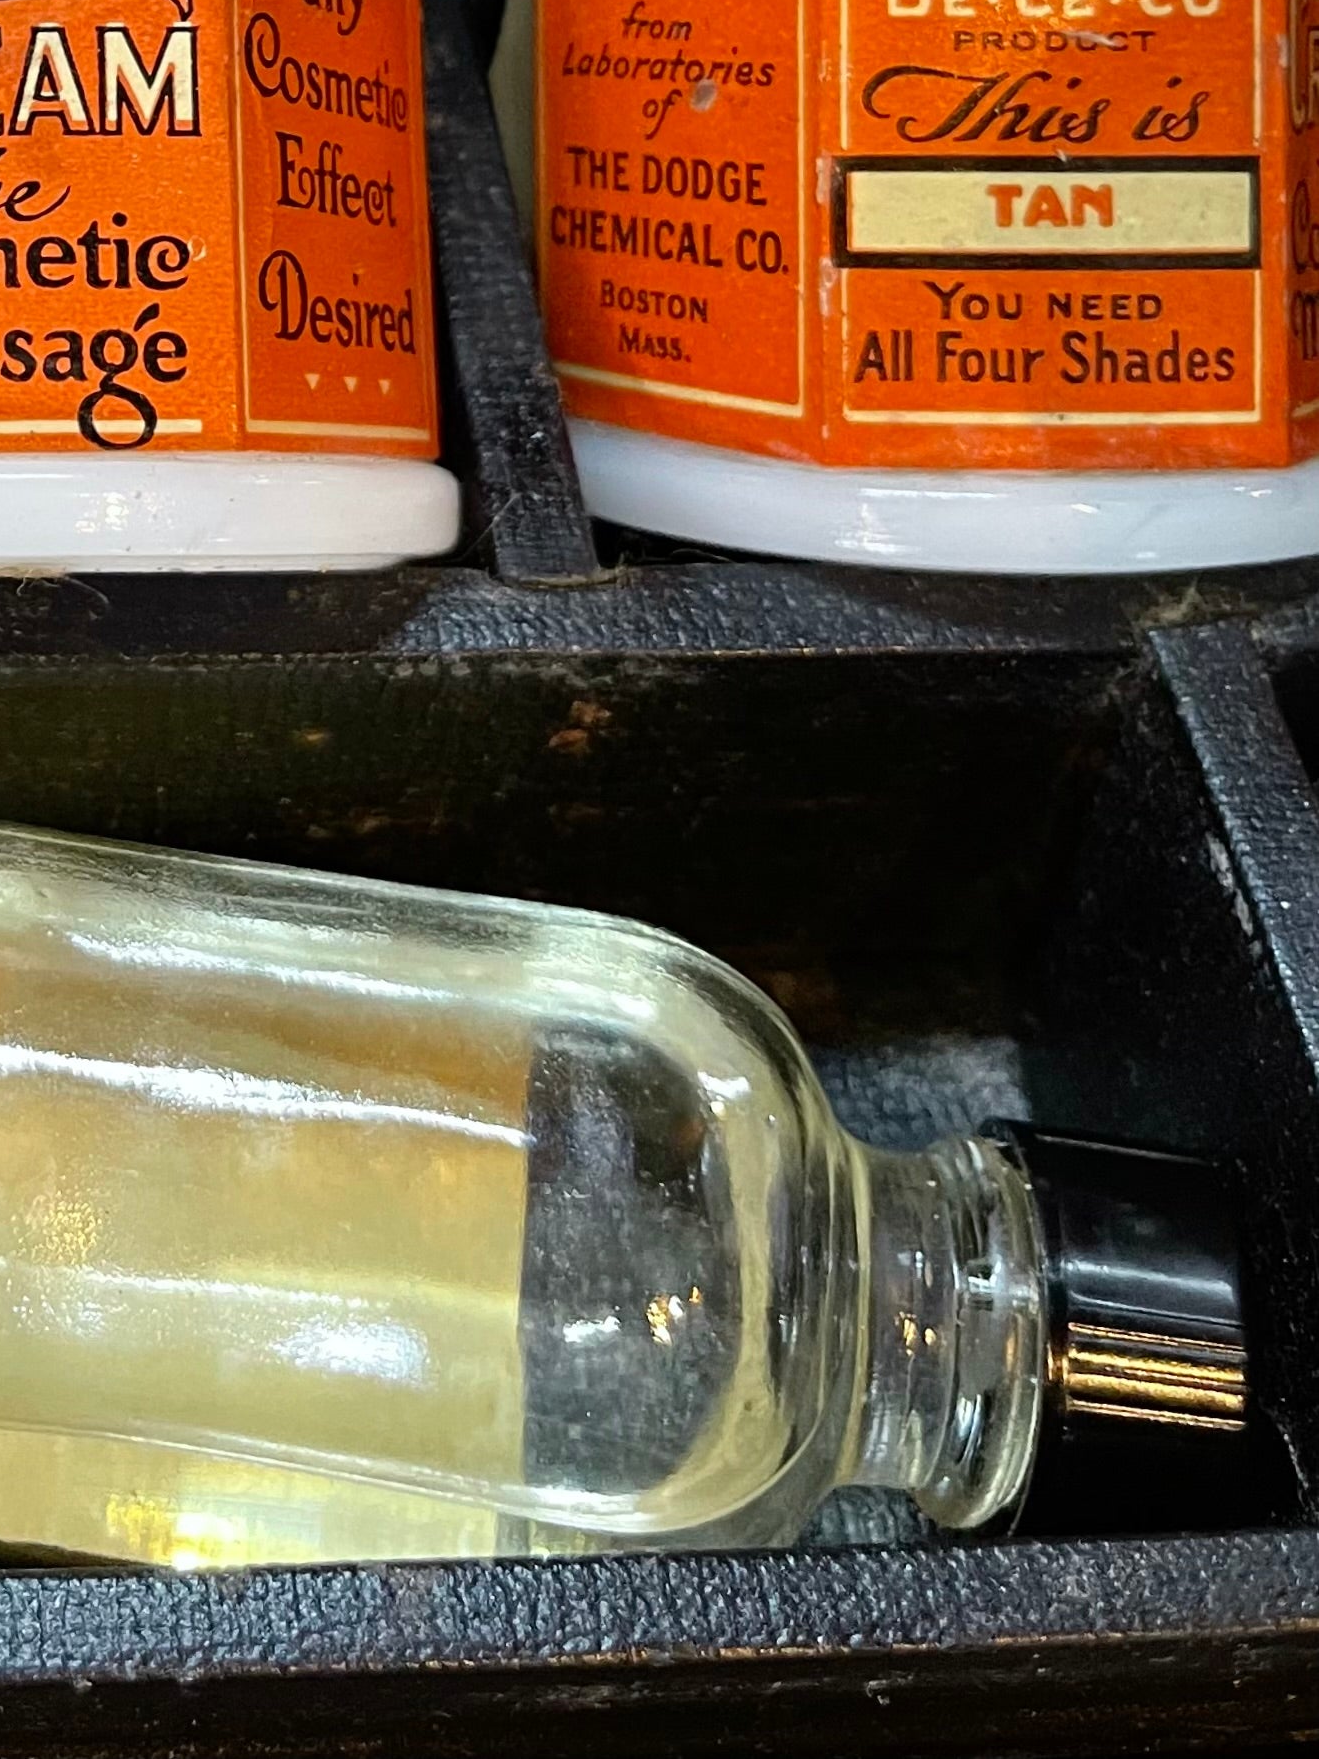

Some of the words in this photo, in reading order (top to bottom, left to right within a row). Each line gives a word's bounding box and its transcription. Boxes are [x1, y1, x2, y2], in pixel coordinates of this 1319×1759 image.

[622, 1, 692, 41] from
[953, 30, 1156, 53] PRODUCT
[244, 12, 408, 132] Cosmetic
[562, 43, 776, 87] Laboratories
[642, 89, 683, 140] of
[862, 65, 1111, 143] This
[1131, 76, 1210, 141] is
[275, 130, 397, 228] Effect
[567, 146, 629, 192] THE
[642, 154, 767, 205] DODGE
[986, 184, 1114, 227] TAN
[550, 205, 723, 268] CHEMICAL
[735, 228, 789, 275] CO.
[258, 250, 416, 354] Desired
[601, 279, 708, 323] BOSTON
[923, 280, 1023, 321] YOU
[1048, 292, 1163, 321] NEED
[618, 324, 692, 363] MASS.
[854, 329, 913, 382] All
[936, 330, 1045, 383] Four
[1060, 329, 1235, 385] Shades
